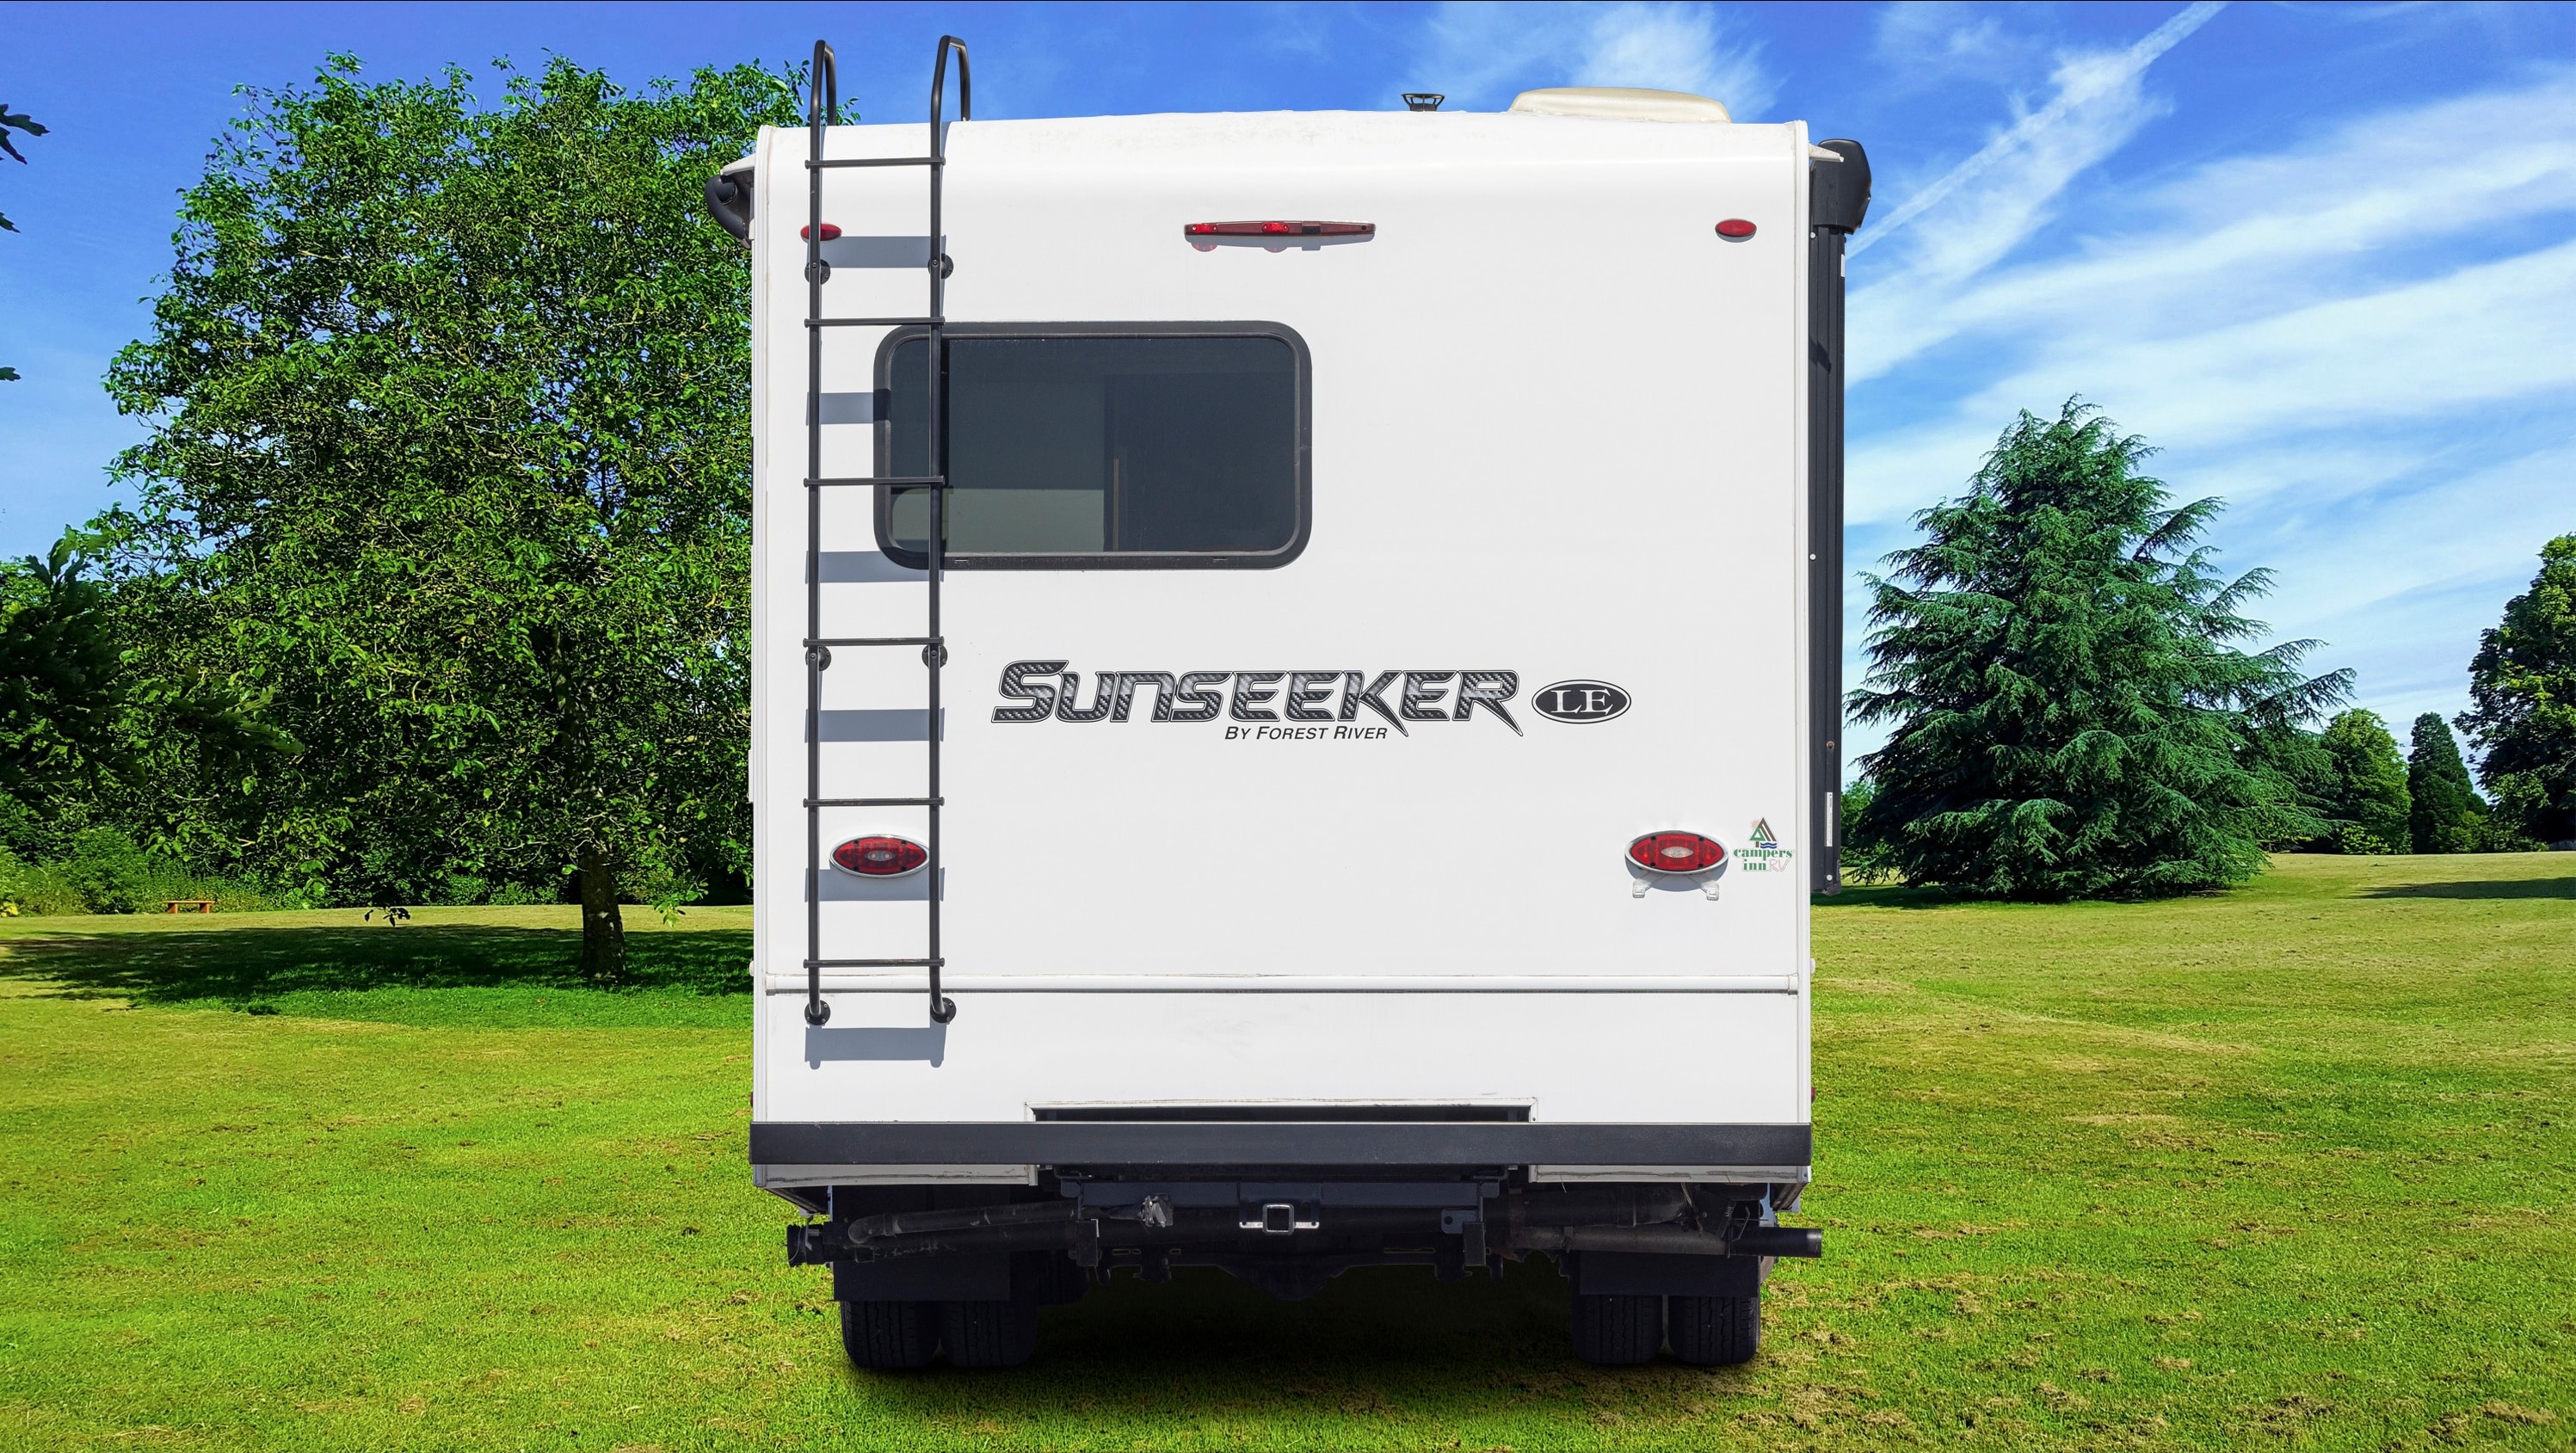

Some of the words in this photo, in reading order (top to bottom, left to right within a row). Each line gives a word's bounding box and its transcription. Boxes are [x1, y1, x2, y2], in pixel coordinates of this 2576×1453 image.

[1550, 688, 1613, 716] LE
[1734, 849, 1793, 861] campers
[1743, 859, 1766, 871] inn
